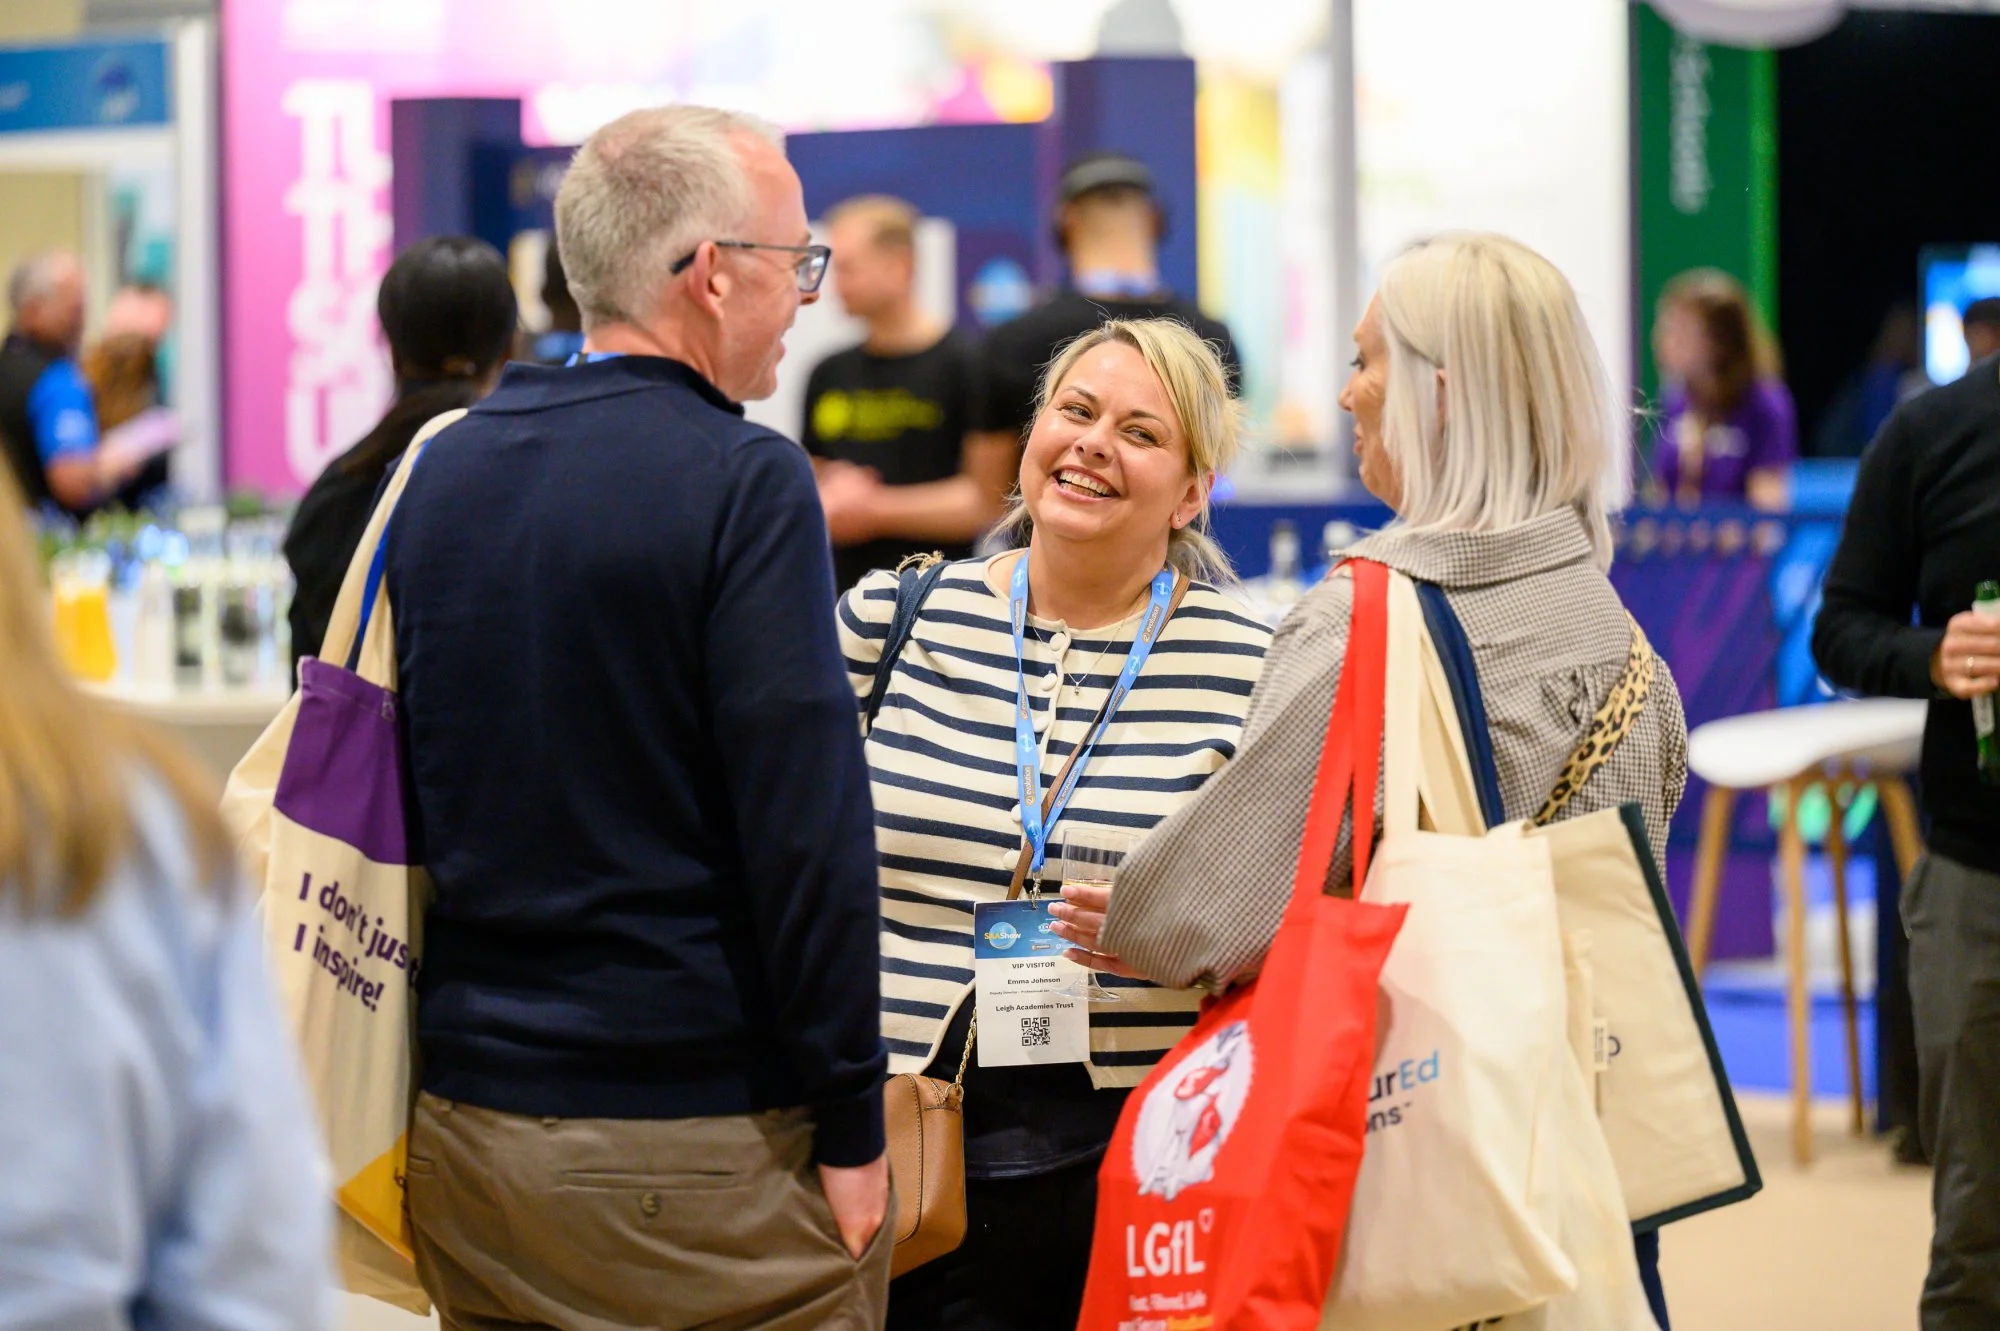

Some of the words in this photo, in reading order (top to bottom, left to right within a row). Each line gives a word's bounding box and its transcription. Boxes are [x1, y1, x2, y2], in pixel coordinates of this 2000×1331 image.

[1023, 766, 1032, 795] evolution
[299, 872, 311, 900] I
[319, 880, 368, 944] don't
[294, 923, 307, 951] I
[313, 924, 384, 1012] inspire!
[1031, 976, 1061, 984] Johnson
[995, 1004, 1015, 1012] Leigh
[1016, 1003, 1054, 1011] Academies
[1126, 1219, 1206, 1278] LGfL
